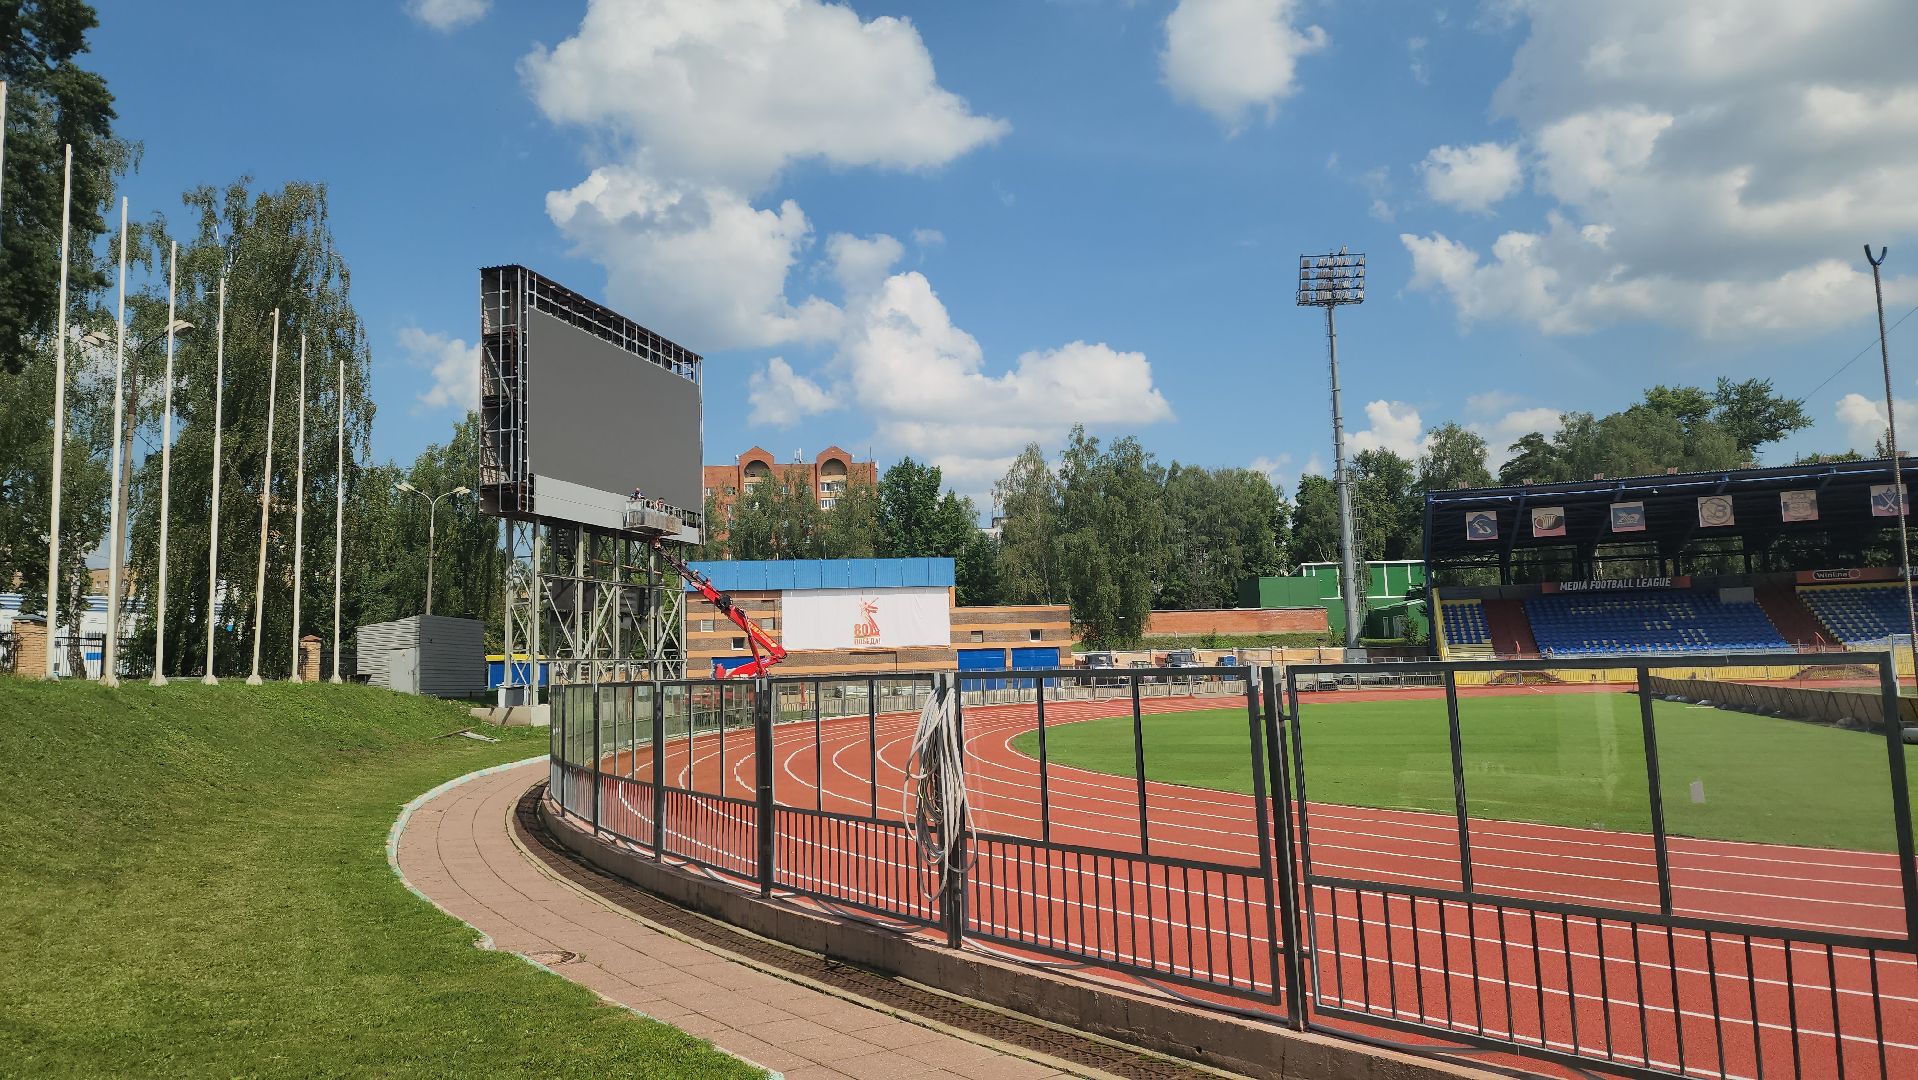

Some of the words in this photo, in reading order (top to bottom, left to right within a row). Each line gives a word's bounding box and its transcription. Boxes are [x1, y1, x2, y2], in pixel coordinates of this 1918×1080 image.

[1560, 581, 1588, 591] MEDIA
[1590, 578, 1634, 590] FOOTBALL
[1636, 577, 1671, 588] LEAGUE
